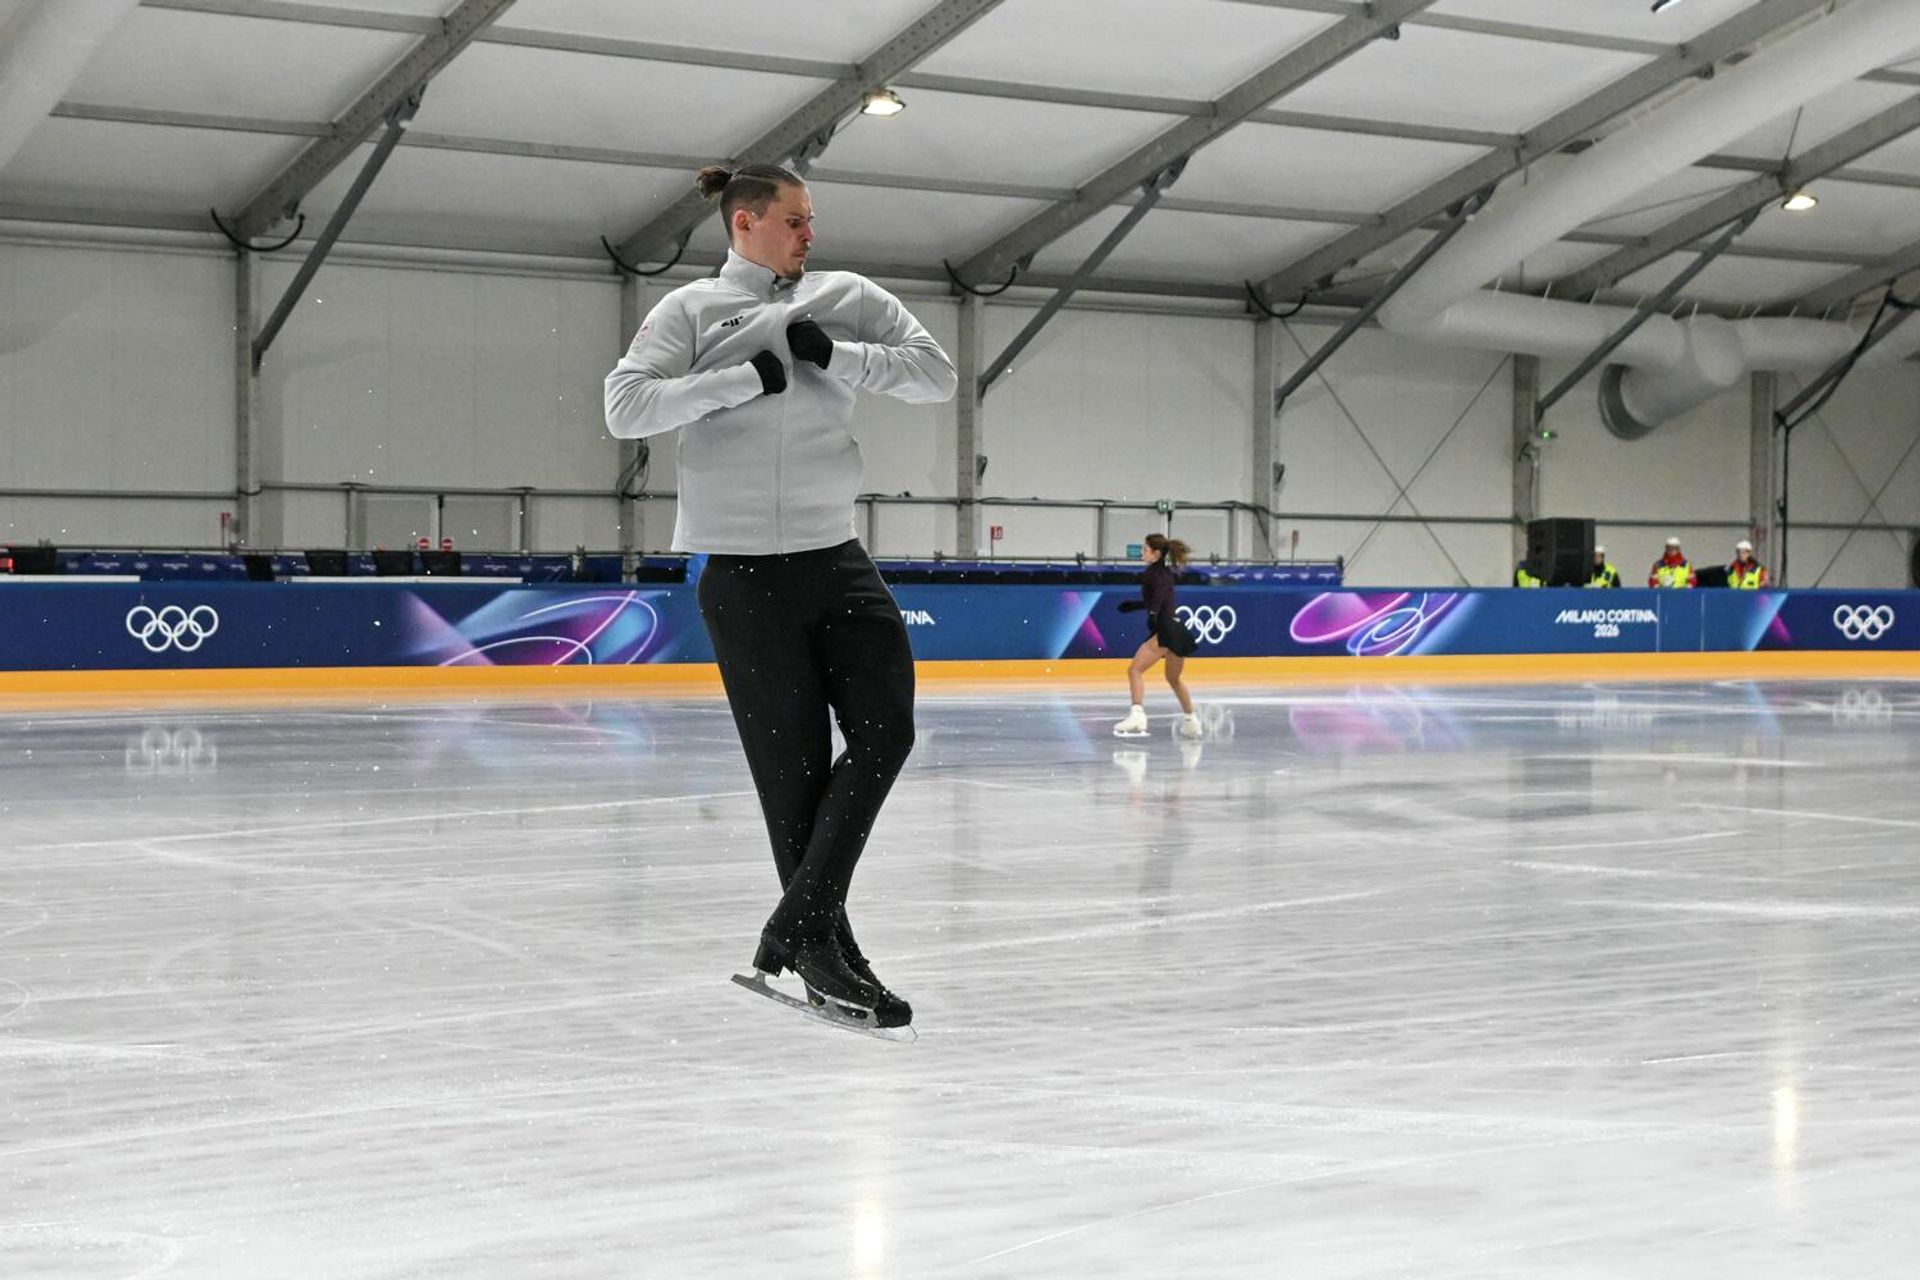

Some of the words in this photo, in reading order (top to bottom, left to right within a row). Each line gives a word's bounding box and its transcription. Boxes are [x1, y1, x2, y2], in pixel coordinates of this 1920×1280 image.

[899, 610, 935, 624] TINA
[1555, 609, 1605, 623] MILANO
[1607, 609, 1658, 623] CORTINA
[1594, 624, 1619, 637] 2026
